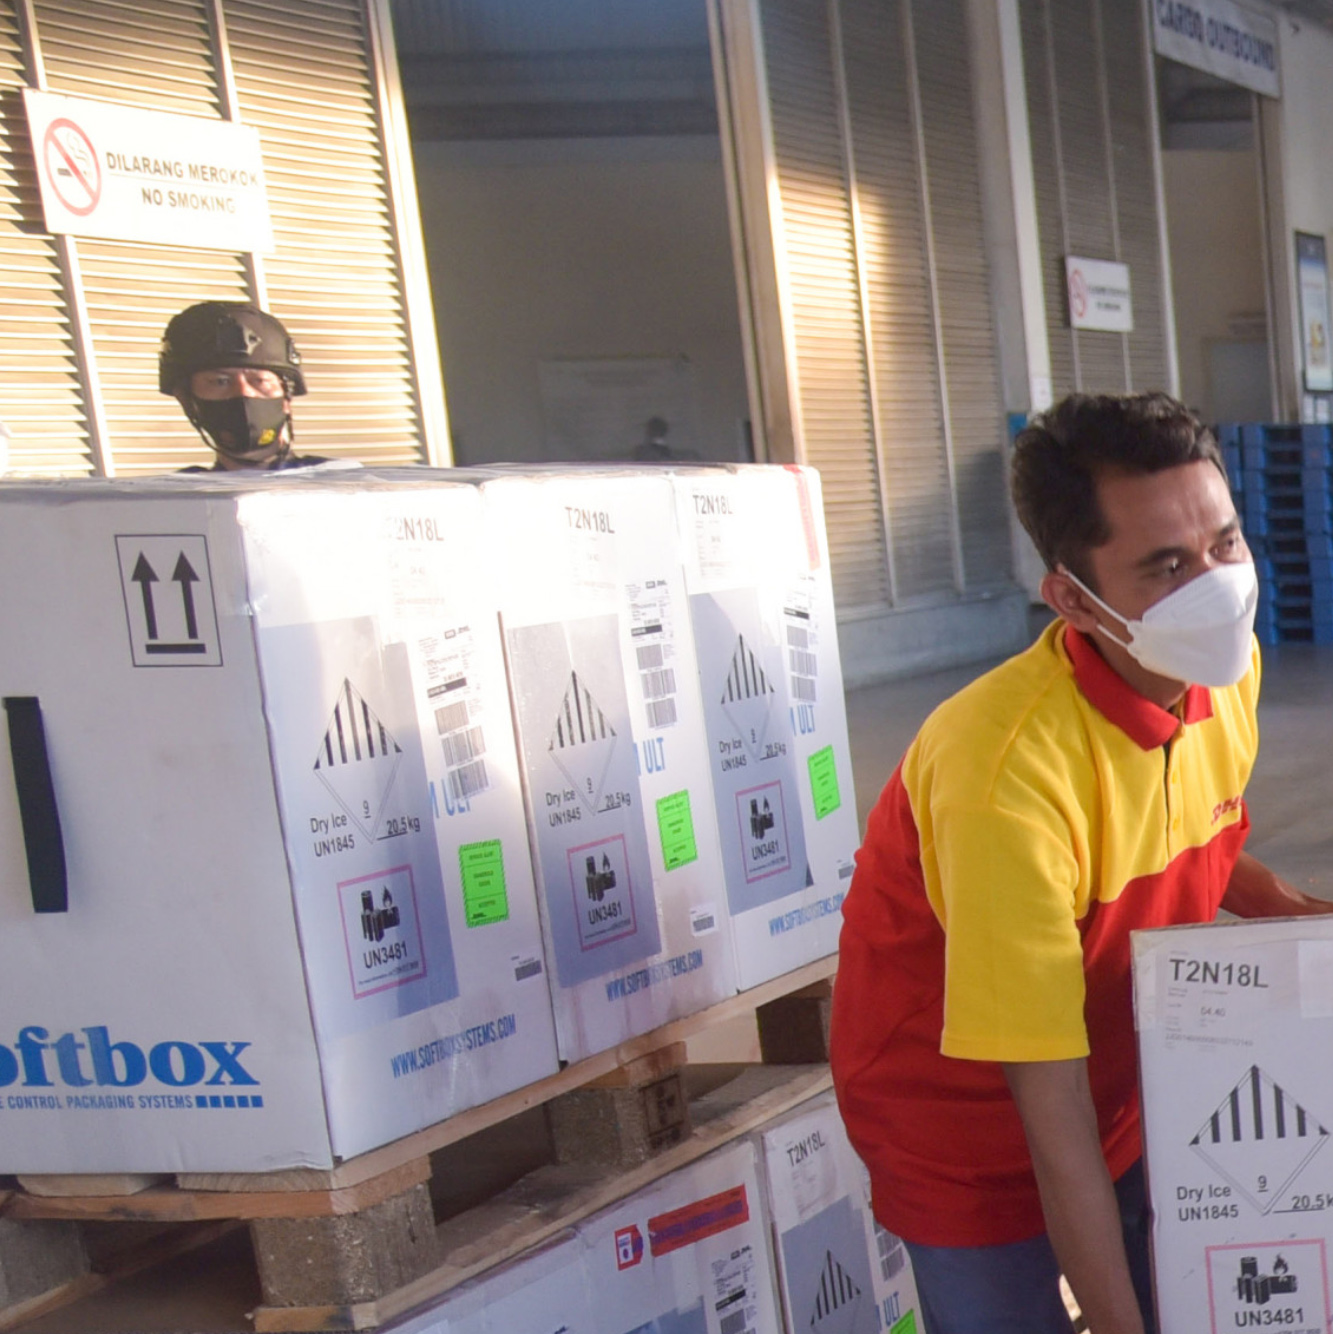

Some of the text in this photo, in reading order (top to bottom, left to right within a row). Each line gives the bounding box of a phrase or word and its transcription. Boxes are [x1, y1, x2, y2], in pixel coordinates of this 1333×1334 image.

[106, 152, 259, 186] DILARANG MEROKOK
[141, 187, 236, 214] NO SMOKING
[692, 494, 733, 515] T2N18L
[565, 506, 616, 534] T2N18L
[798, 705, 816, 735] ULT
[643, 737, 666, 774] ULT
[362, 800, 370, 815] 9
[545, 788, 576, 807] Dry Ice
[310, 812, 348, 835] Dry Ice
[549, 807, 582, 828] UN1845
[314, 834, 356, 858] UN1845
[751, 840, 780, 861] UN3481
[588, 901, 624, 925] UN3481
[363, 941, 408, 969] UN3481
[1169, 958, 1269, 988] T2N18L
[0, 1025, 260, 1088] ftbox
[390, 1013, 517, 1079] WWW.SOFTBOXSYSTEMS.COM
[8, 1094, 194, 1110] CONTROL PACKAGING SYSTEMS
[787, 1130, 826, 1168] T2N18L
[1176, 1184, 1231, 1202] Dry Ice
[1257, 1175, 1268, 1190] 9
[1178, 1204, 1239, 1222] UN1845
[1234, 1307, 1304, 1328] UN3481
